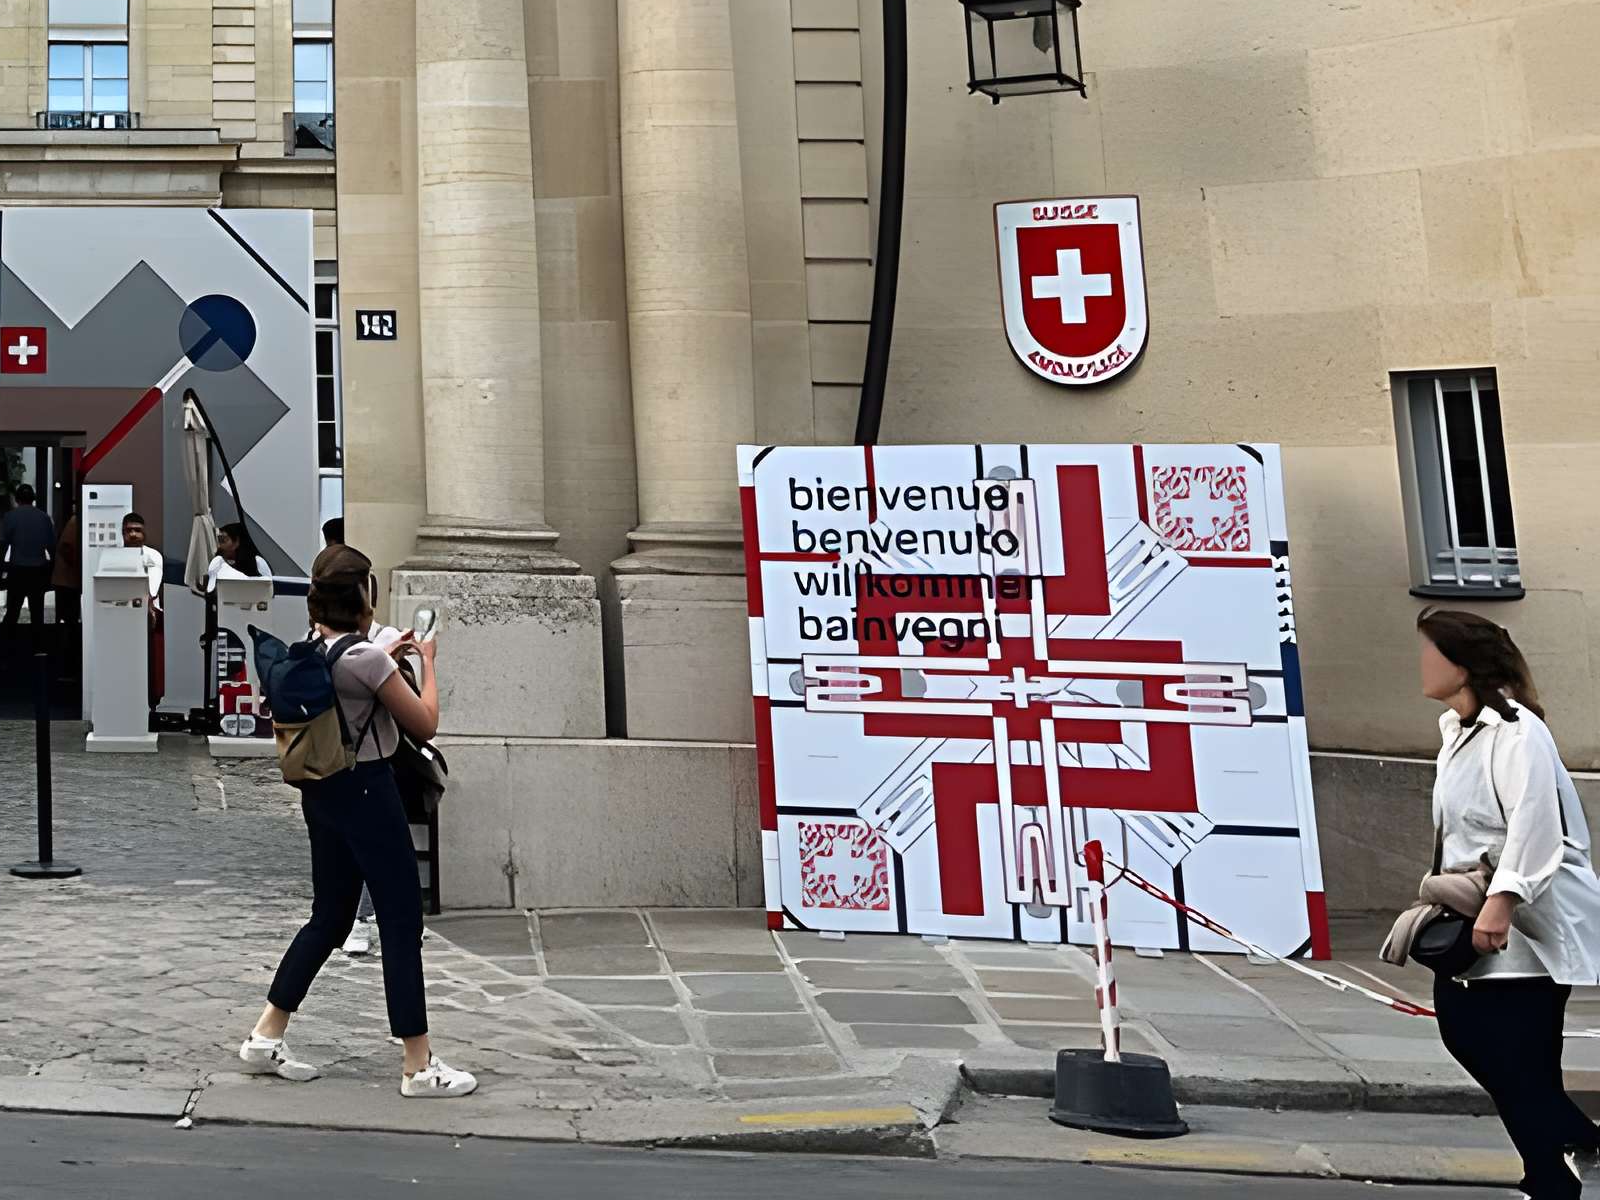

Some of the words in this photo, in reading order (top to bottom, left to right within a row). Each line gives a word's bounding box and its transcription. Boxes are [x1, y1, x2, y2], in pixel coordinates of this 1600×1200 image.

[788, 477, 1010, 511] bienvenue
[791, 519, 1020, 556] benvenuto
[798, 606, 1001, 651] bainvegni
